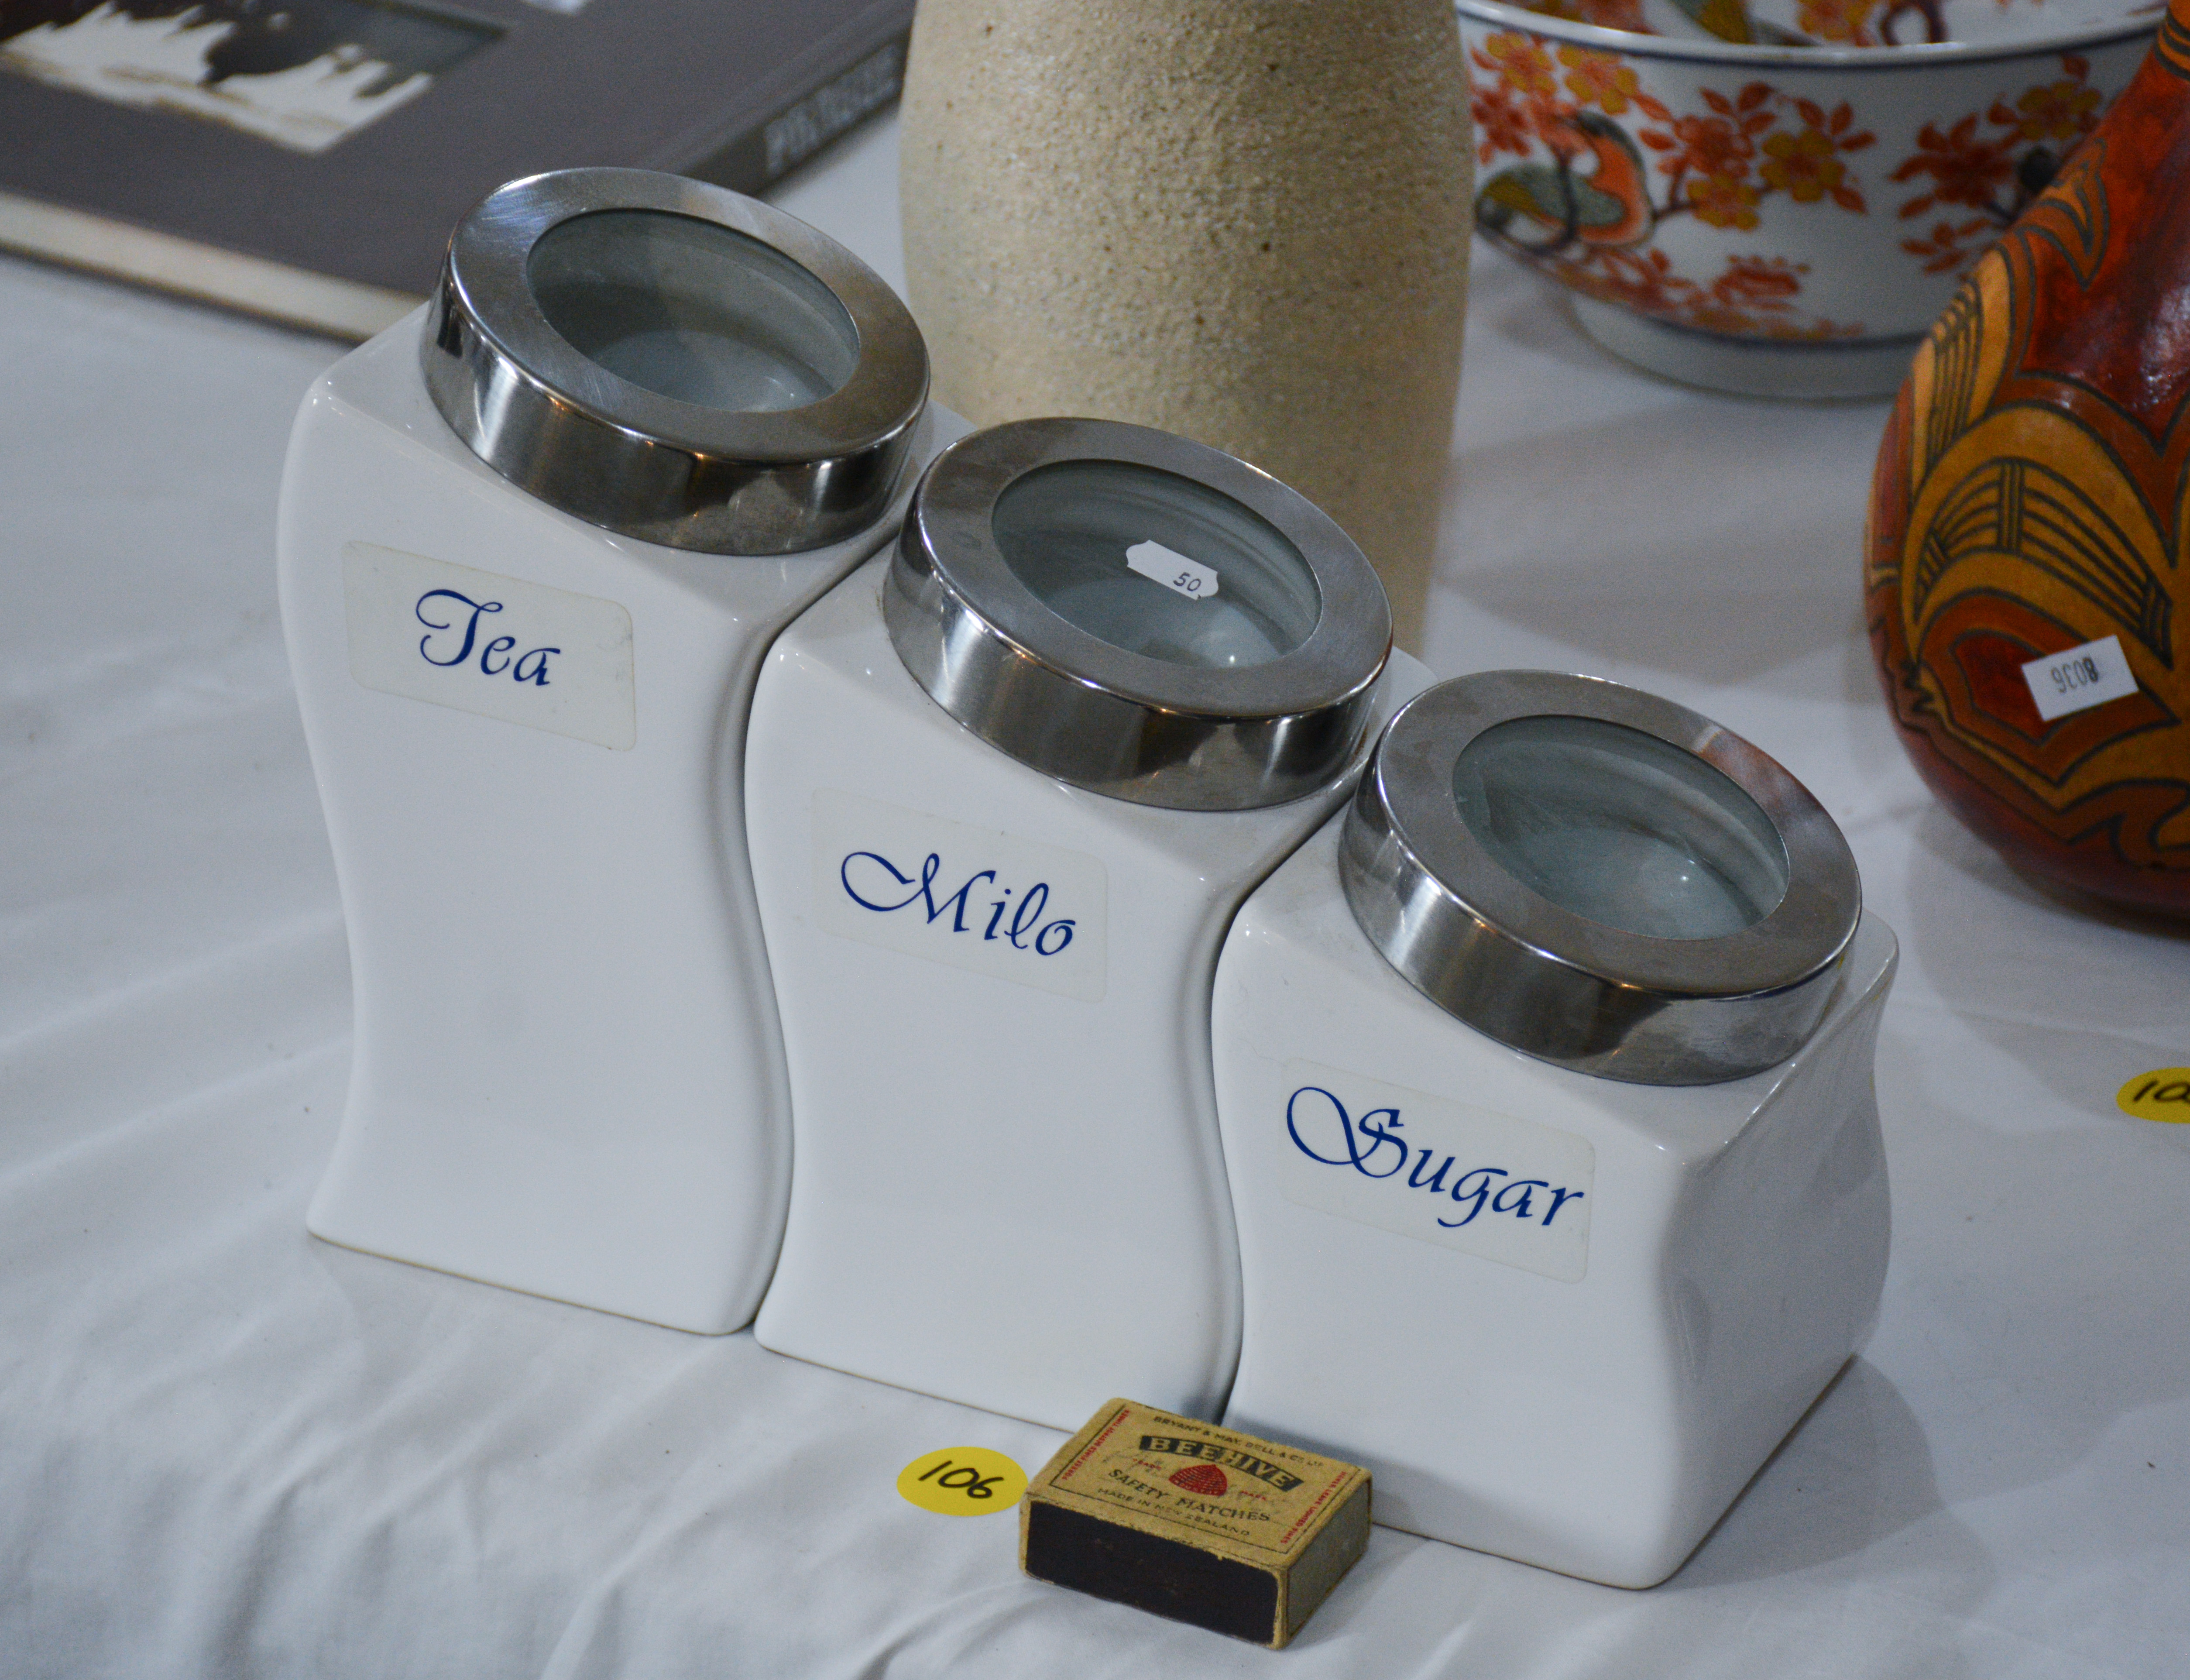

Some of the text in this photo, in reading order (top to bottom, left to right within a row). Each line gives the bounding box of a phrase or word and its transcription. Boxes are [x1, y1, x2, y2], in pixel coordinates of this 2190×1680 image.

[1173, 572, 1201, 591] 50
[416, 589, 560, 686] Tea
[841, 852, 1075, 956] Milo
[2133, 1080, 2190, 1105] 10
[1287, 1087, 1584, 1227] Sugar
[1153, 1416, 1201, 1433] BRYANT
[1245, 1442, 1275, 1455] BELL
[918, 1460, 1004, 1498] 106
[1149, 1438, 1293, 1488] BEEHIVE
[1097, 1488, 1135, 1501] MADE
[1185, 1514, 1250, 1536] ZEALAND
[1109, 1469, 1270, 1522] SAFETY MATCHES
